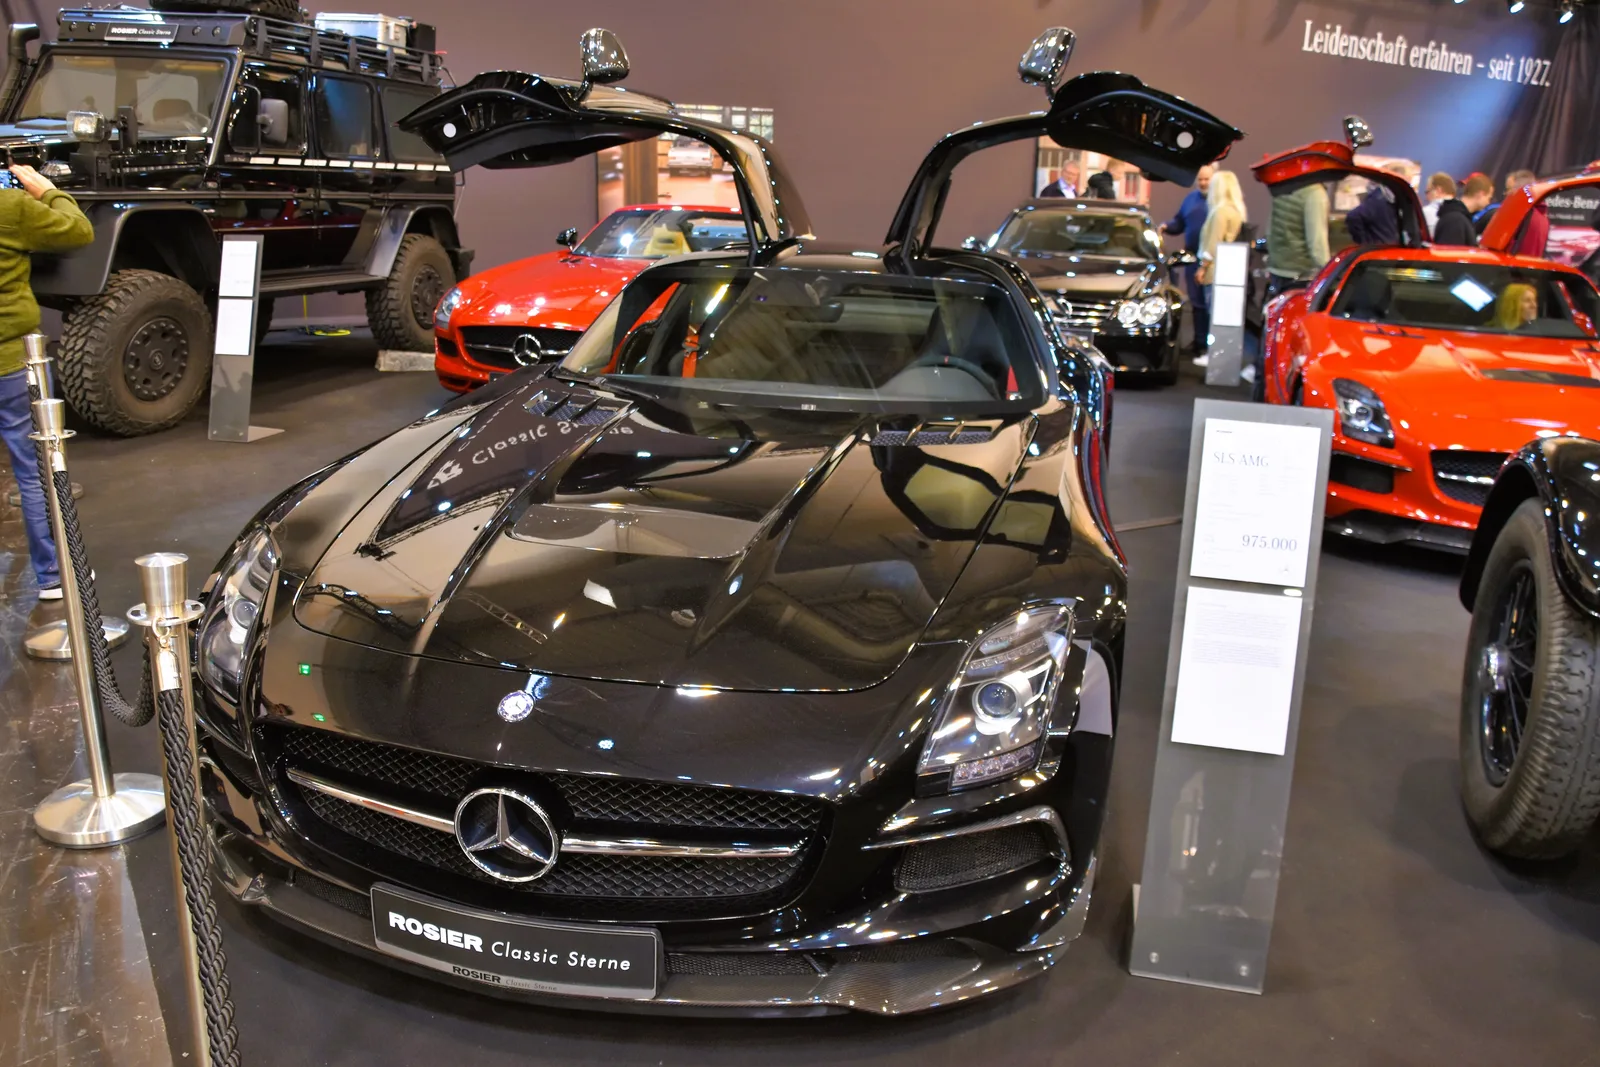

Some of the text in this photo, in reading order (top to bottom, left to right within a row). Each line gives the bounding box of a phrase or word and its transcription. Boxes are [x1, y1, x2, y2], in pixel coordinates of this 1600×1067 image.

[111, 27, 138, 35] ROSIER
[1302, 20, 1408, 66] Leidenschaft
[1409, 40, 1473, 76] erfahren
[1487, 54, 1515, 82] seit
[1516, 56, 1552, 87] 1927.
[1545, 194, 1600, 210] edes-Benz
[1213, 451, 1270, 468] SLS AMG
[1242, 534, 1298, 552] 975.000
[388, 911, 631, 971] ROSIER Classic Sterne
[452, 965, 557, 991] ROSIER Classic Sterne
